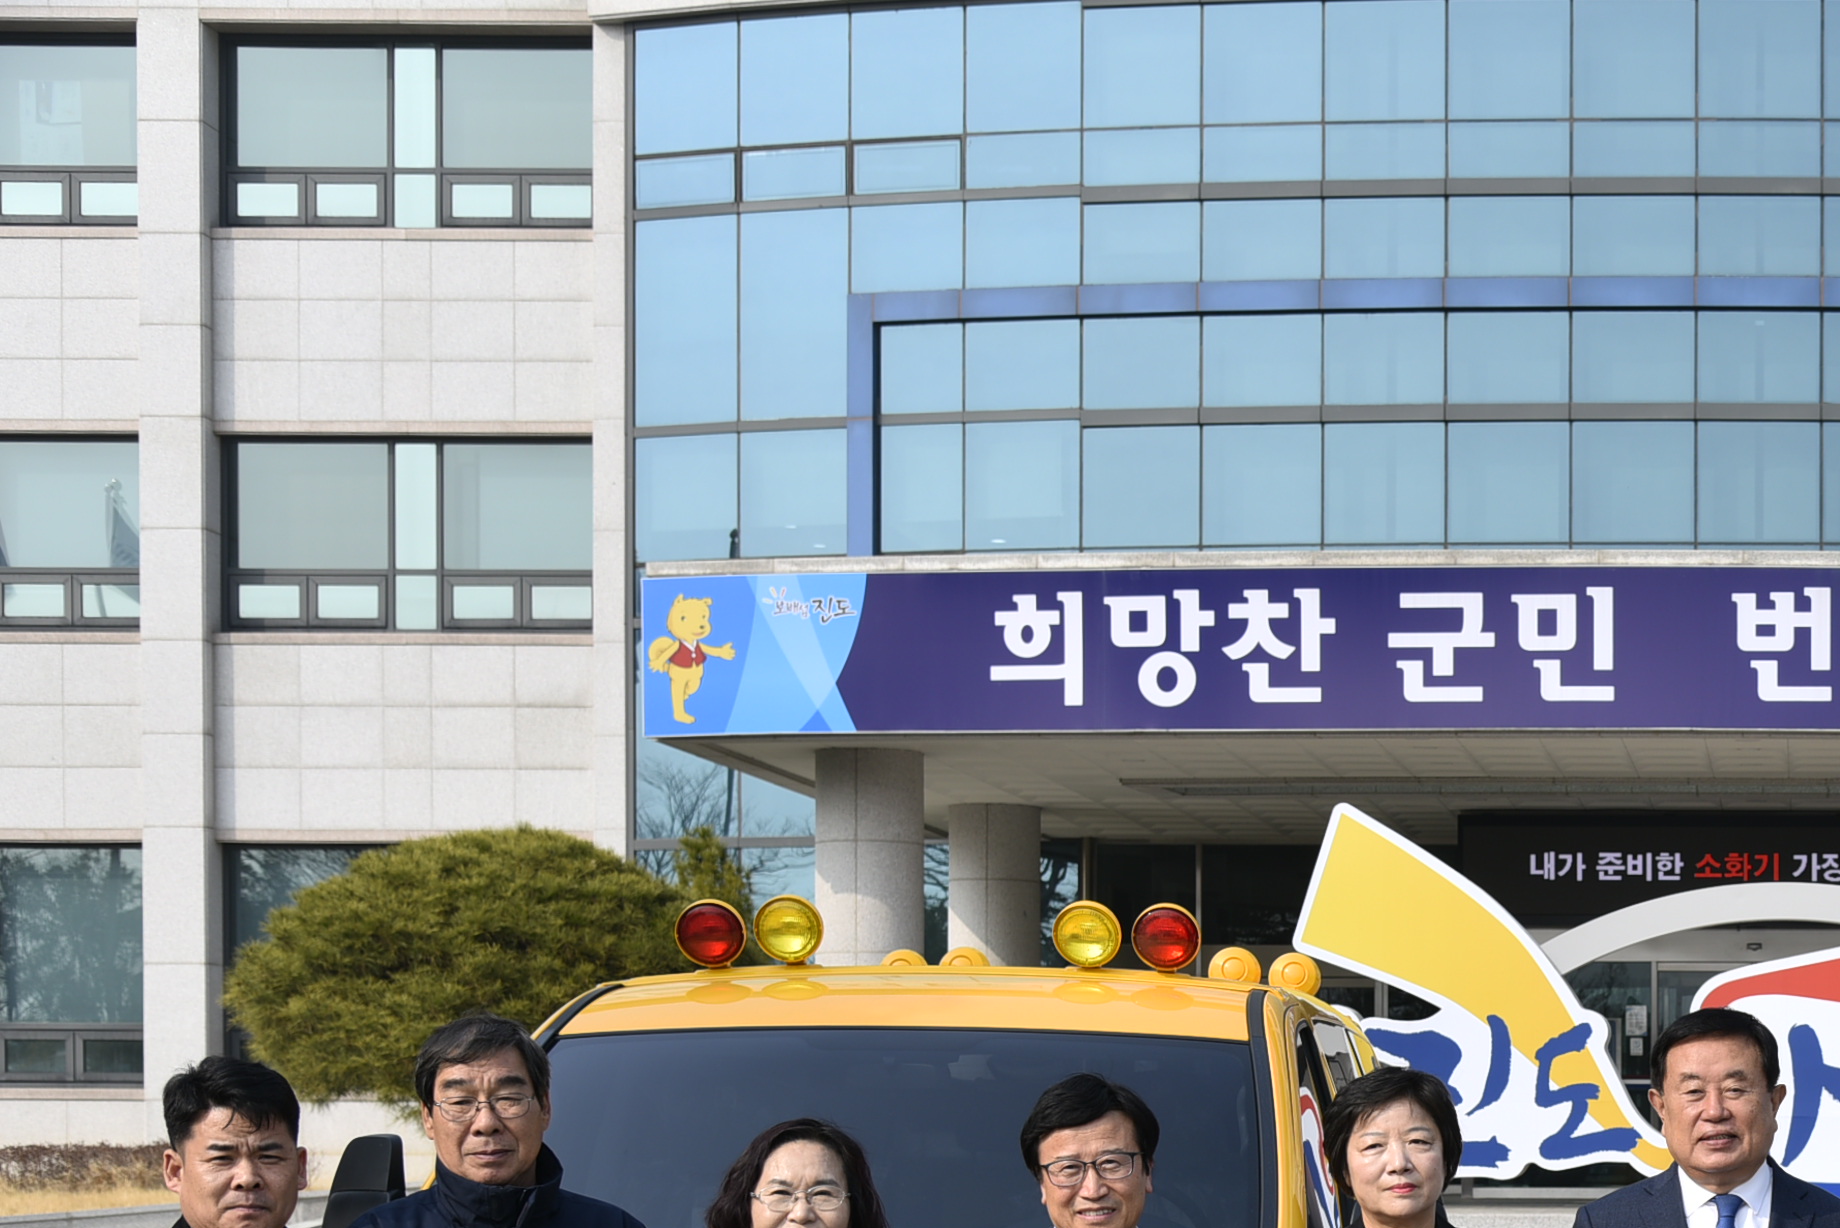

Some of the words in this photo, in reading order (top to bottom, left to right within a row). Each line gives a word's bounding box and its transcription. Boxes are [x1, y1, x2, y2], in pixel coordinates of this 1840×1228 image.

[811, 596, 857, 623] 진도
[989, 588, 1336, 708] 희망찬
[1387, 586, 1616, 703] 군민
[1529, 851, 1586, 881] 내가
[1595, 852, 1684, 881] 준비한
[1695, 852, 1781, 881] 소화기
